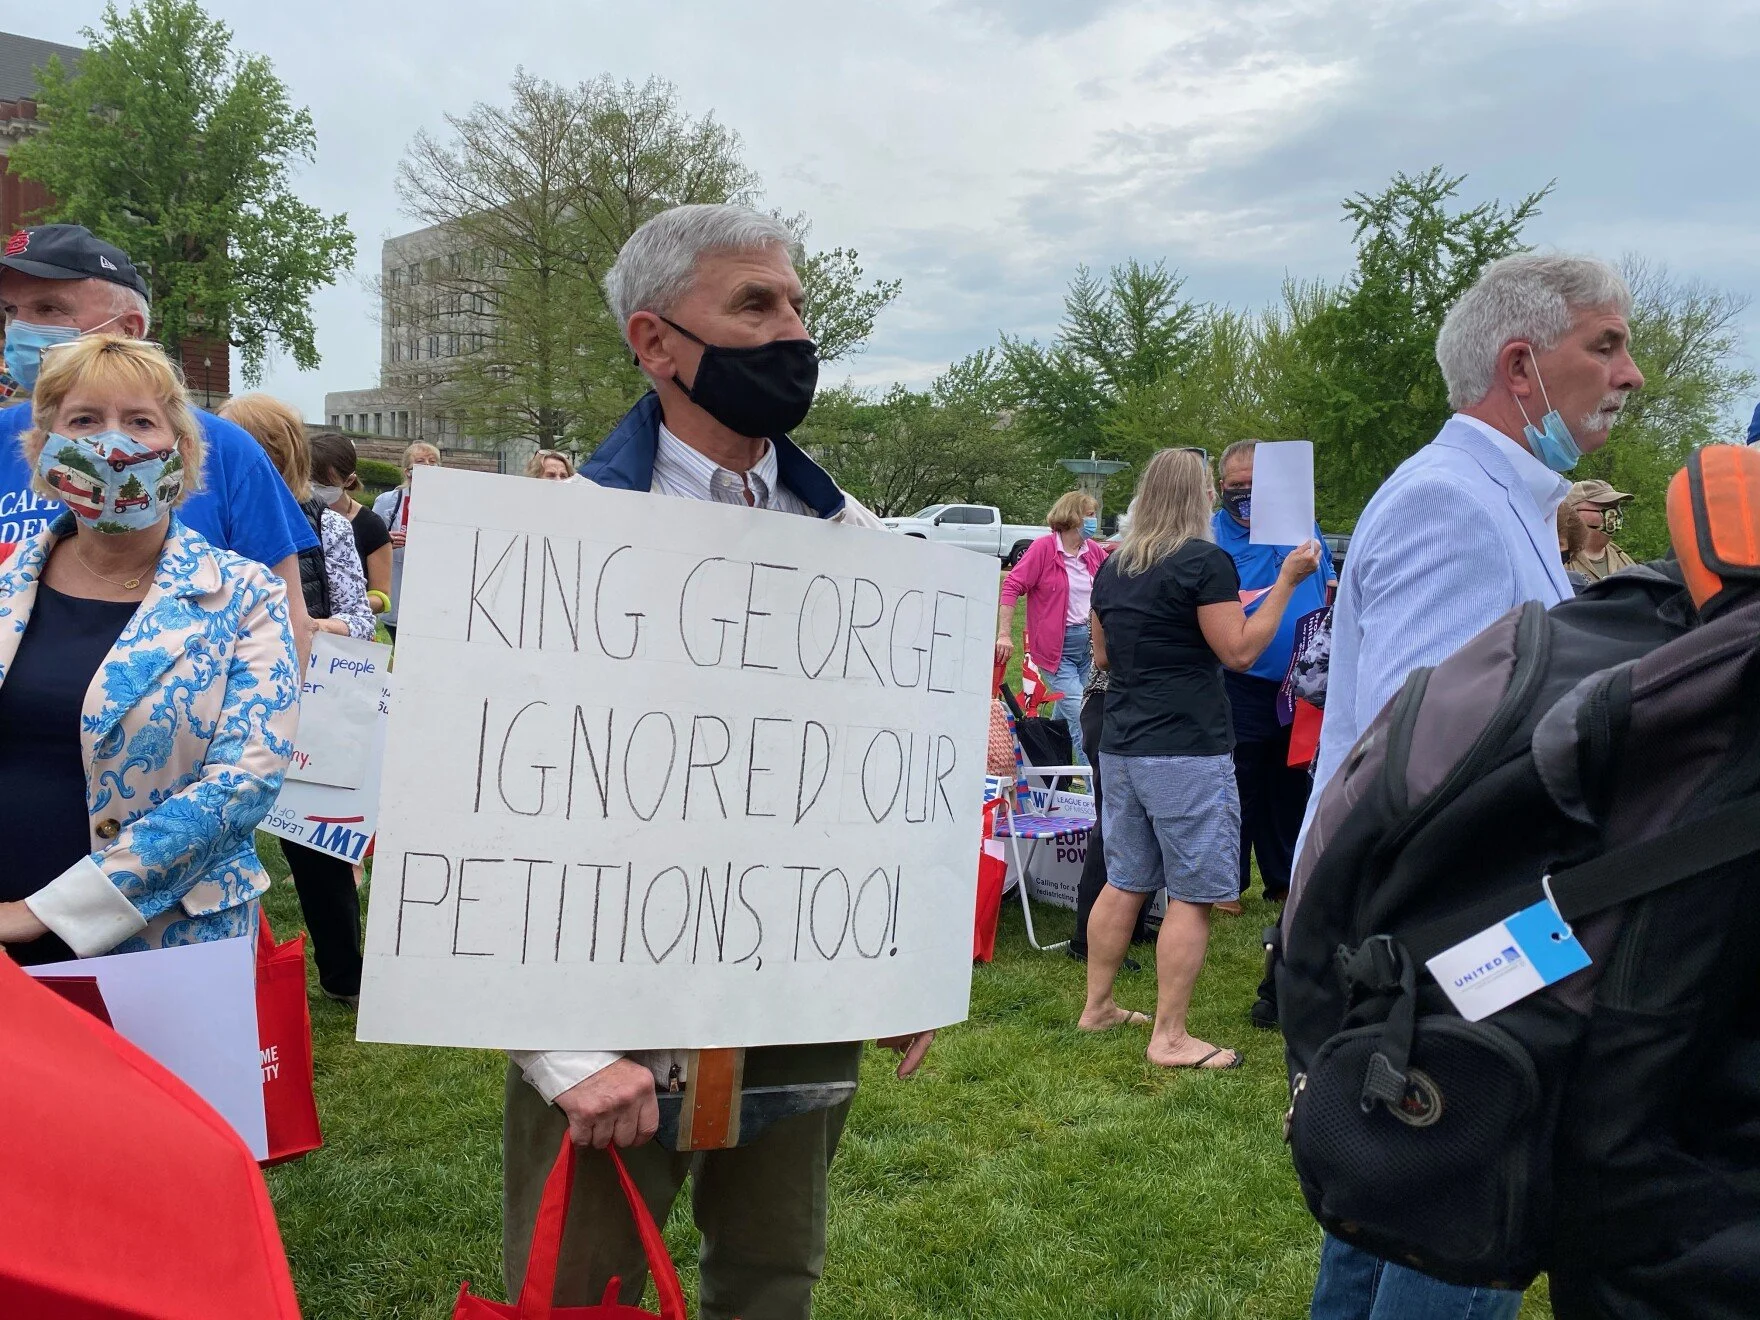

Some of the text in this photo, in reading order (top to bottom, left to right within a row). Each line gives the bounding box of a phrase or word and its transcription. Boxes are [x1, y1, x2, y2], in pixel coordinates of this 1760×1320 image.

[466, 530, 966, 694] KING GEORGE
[329, 657, 376, 678] people
[473, 697, 957, 827] IGNORED OUR
[280, 807, 296, 820] OF
[1057, 796, 1081, 807] LEAGUE
[307, 821, 370, 861] LWV
[1035, 877, 1059, 890] Calling
[1060, 882, 1070, 890] for
[1036, 888, 1074, 903] redistricting
[395, 852, 902, 972] PETITIONS, TOO!
[1454, 957, 1503, 988] UNITED
